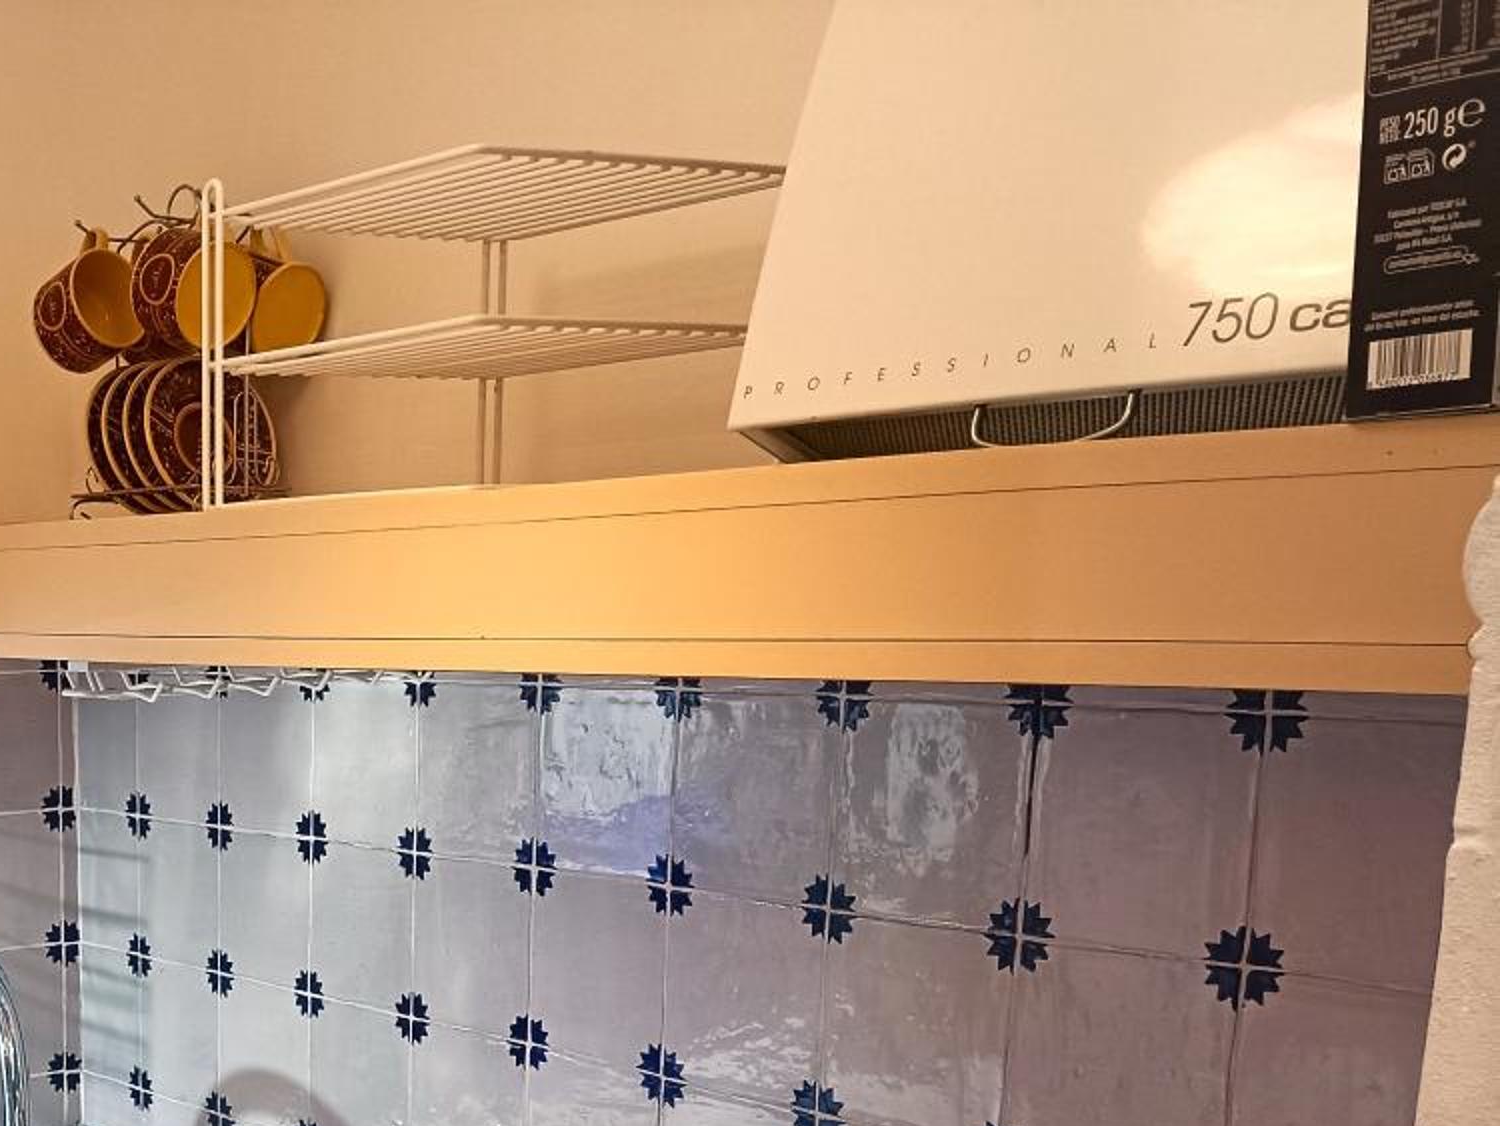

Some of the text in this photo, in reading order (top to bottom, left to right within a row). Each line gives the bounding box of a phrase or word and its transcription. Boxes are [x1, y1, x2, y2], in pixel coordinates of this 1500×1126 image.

[1403, 106, 1439, 139] 250
[743, 333, 1158, 400] PROFESSIONAL
[1182, 292, 1279, 347] 750
